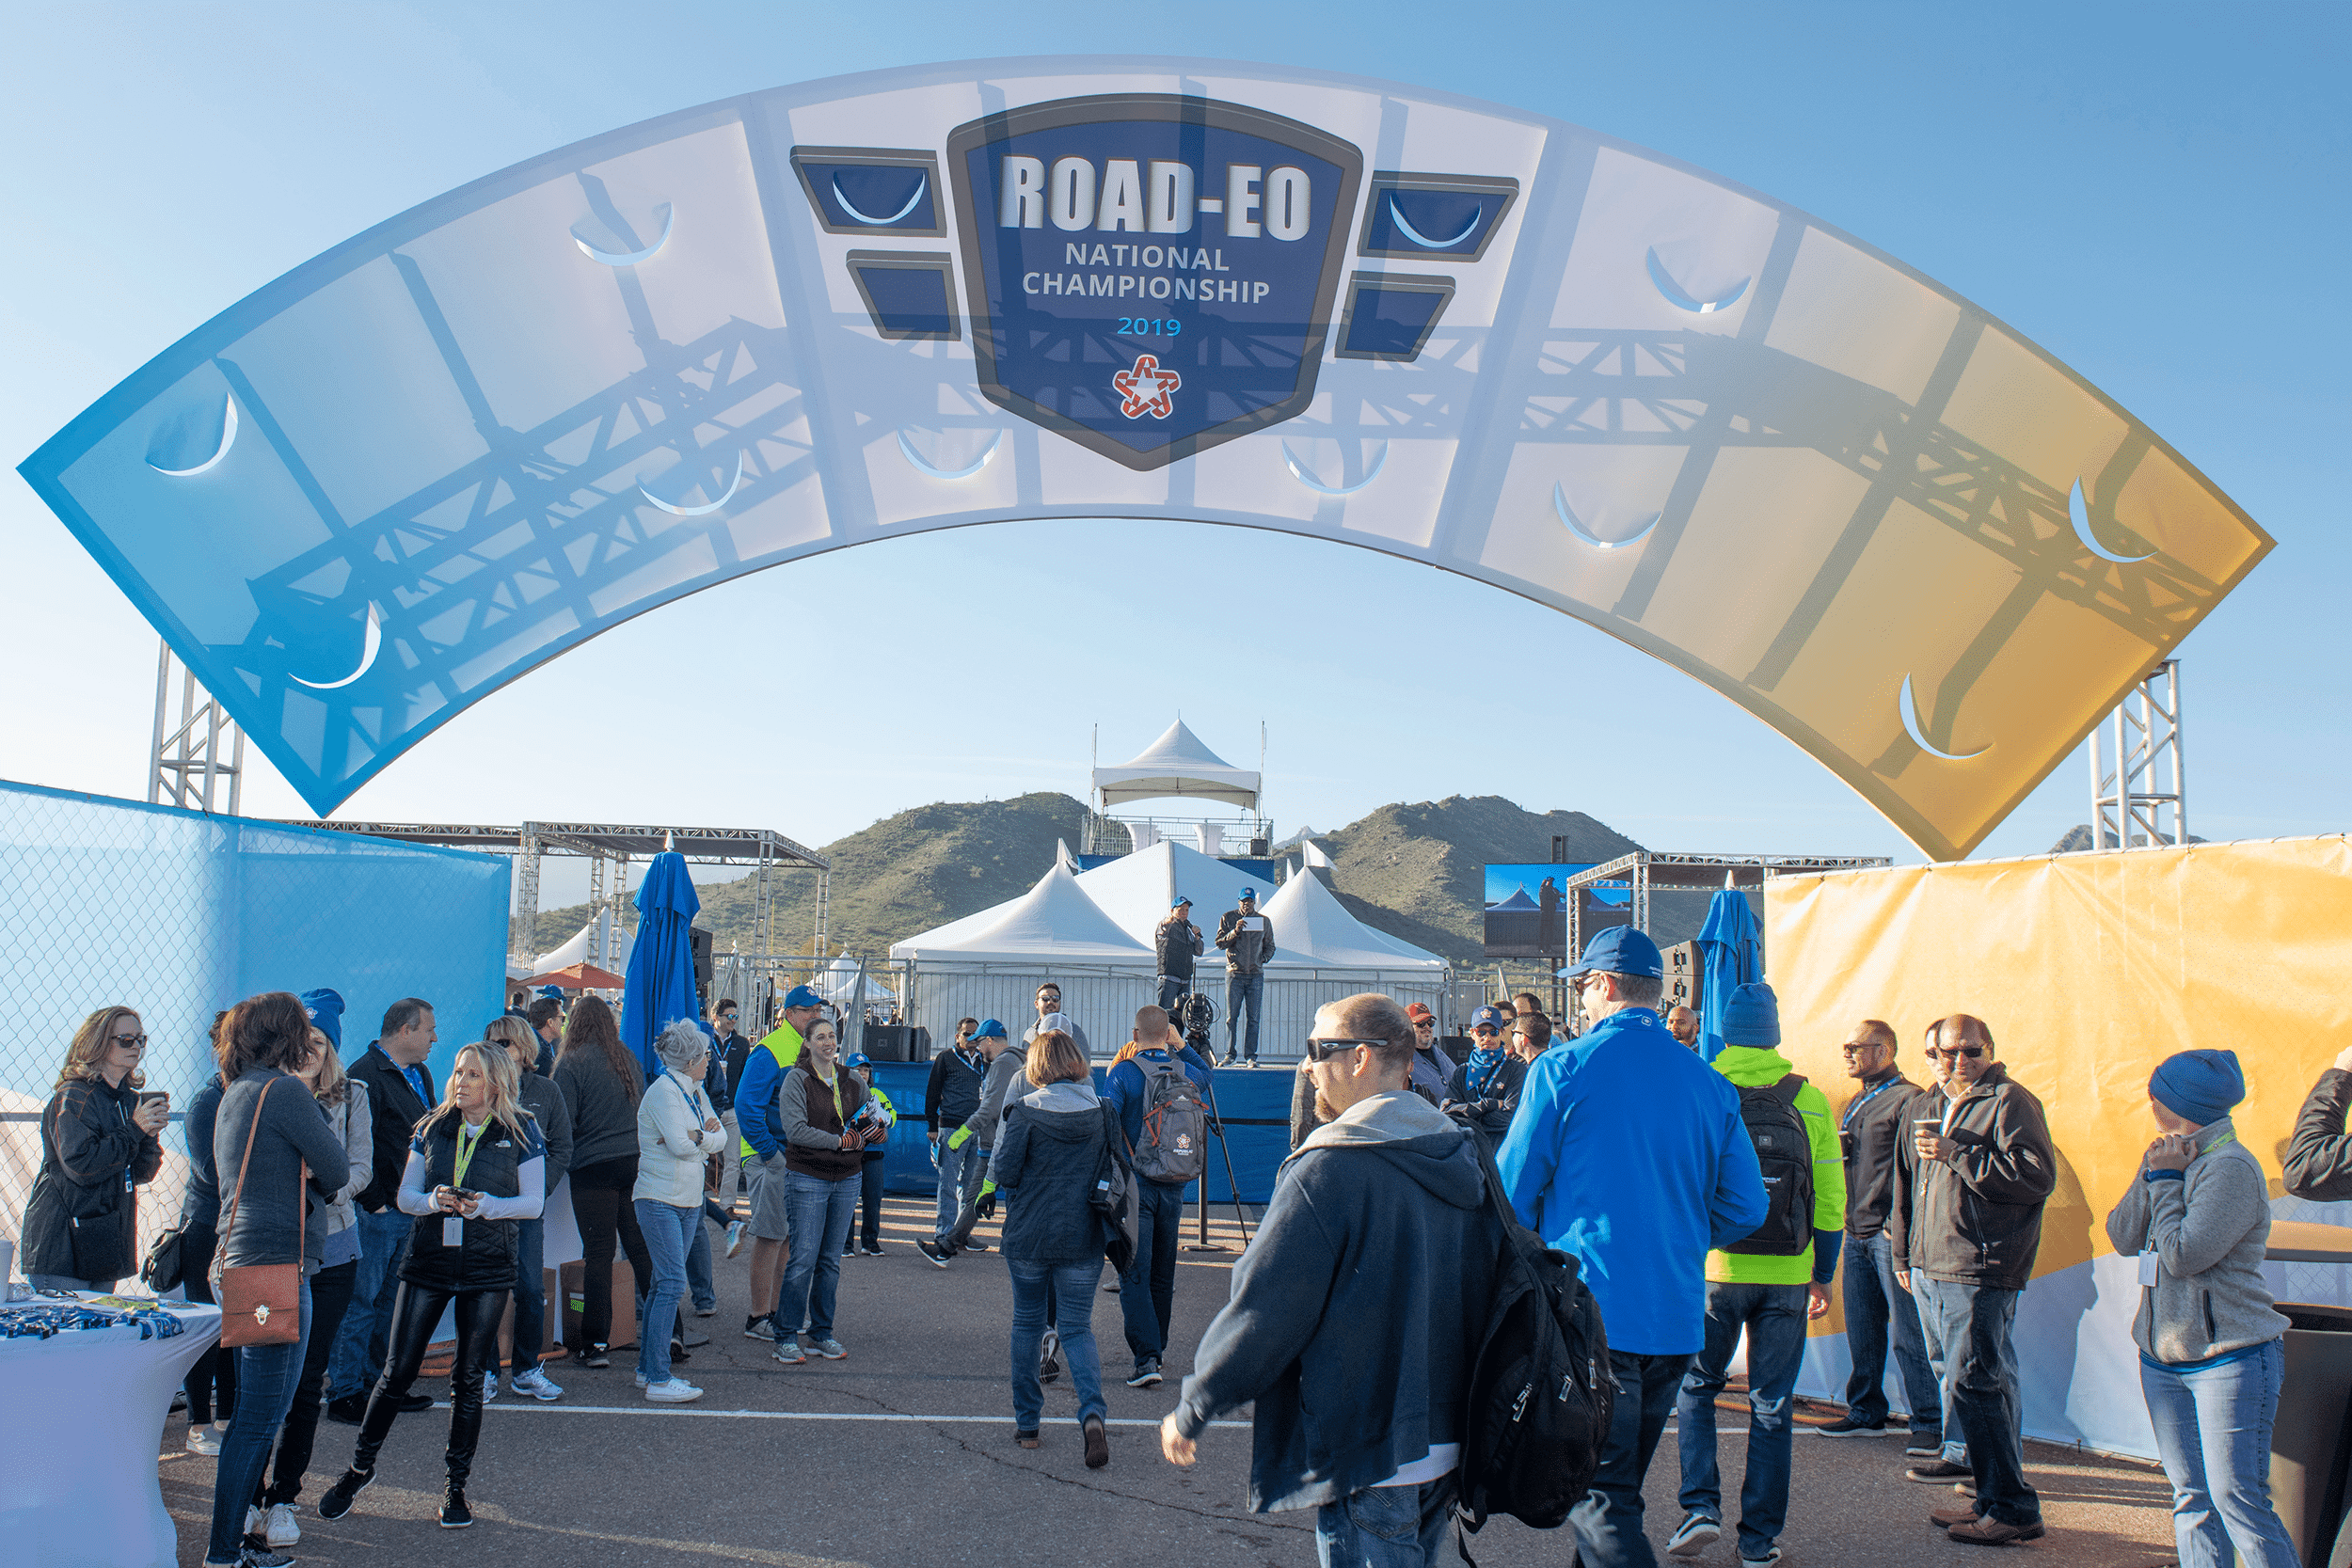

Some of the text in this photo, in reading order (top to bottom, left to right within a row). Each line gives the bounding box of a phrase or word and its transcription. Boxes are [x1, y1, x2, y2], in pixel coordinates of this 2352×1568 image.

[998, 154, 1311, 242] ROAD-EO
[1065, 243, 1230, 271] NATIONAL
[1022, 272, 1270, 304] CHAMPIONSHIP
[1117, 317, 1182, 337] 2019
